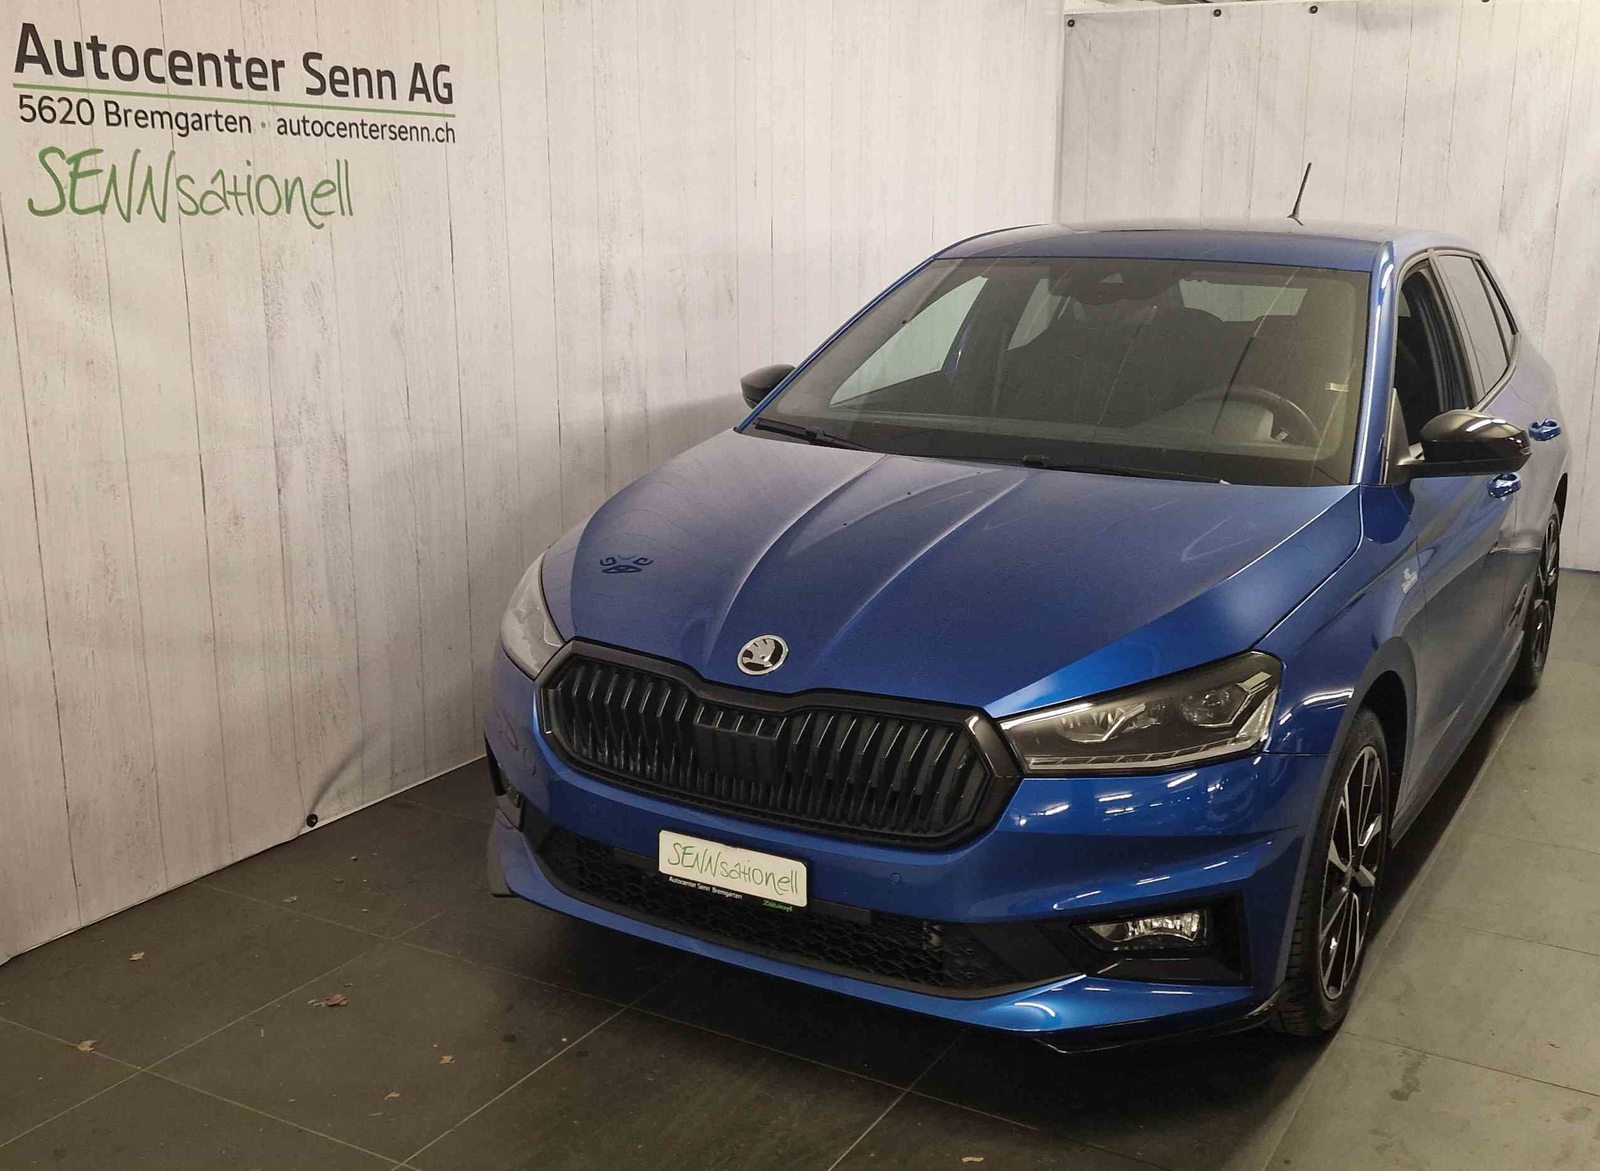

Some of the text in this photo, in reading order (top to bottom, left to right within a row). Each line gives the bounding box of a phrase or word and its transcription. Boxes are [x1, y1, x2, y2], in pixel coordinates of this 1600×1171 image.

[14, 22, 454, 105] Autocenter Senn AG
[19, 94, 456, 143] 5620 Bremgarten autocentersenn.ch
[28, 146, 354, 229] SENNsationell
[668, 842, 798, 896] SENNsationell
